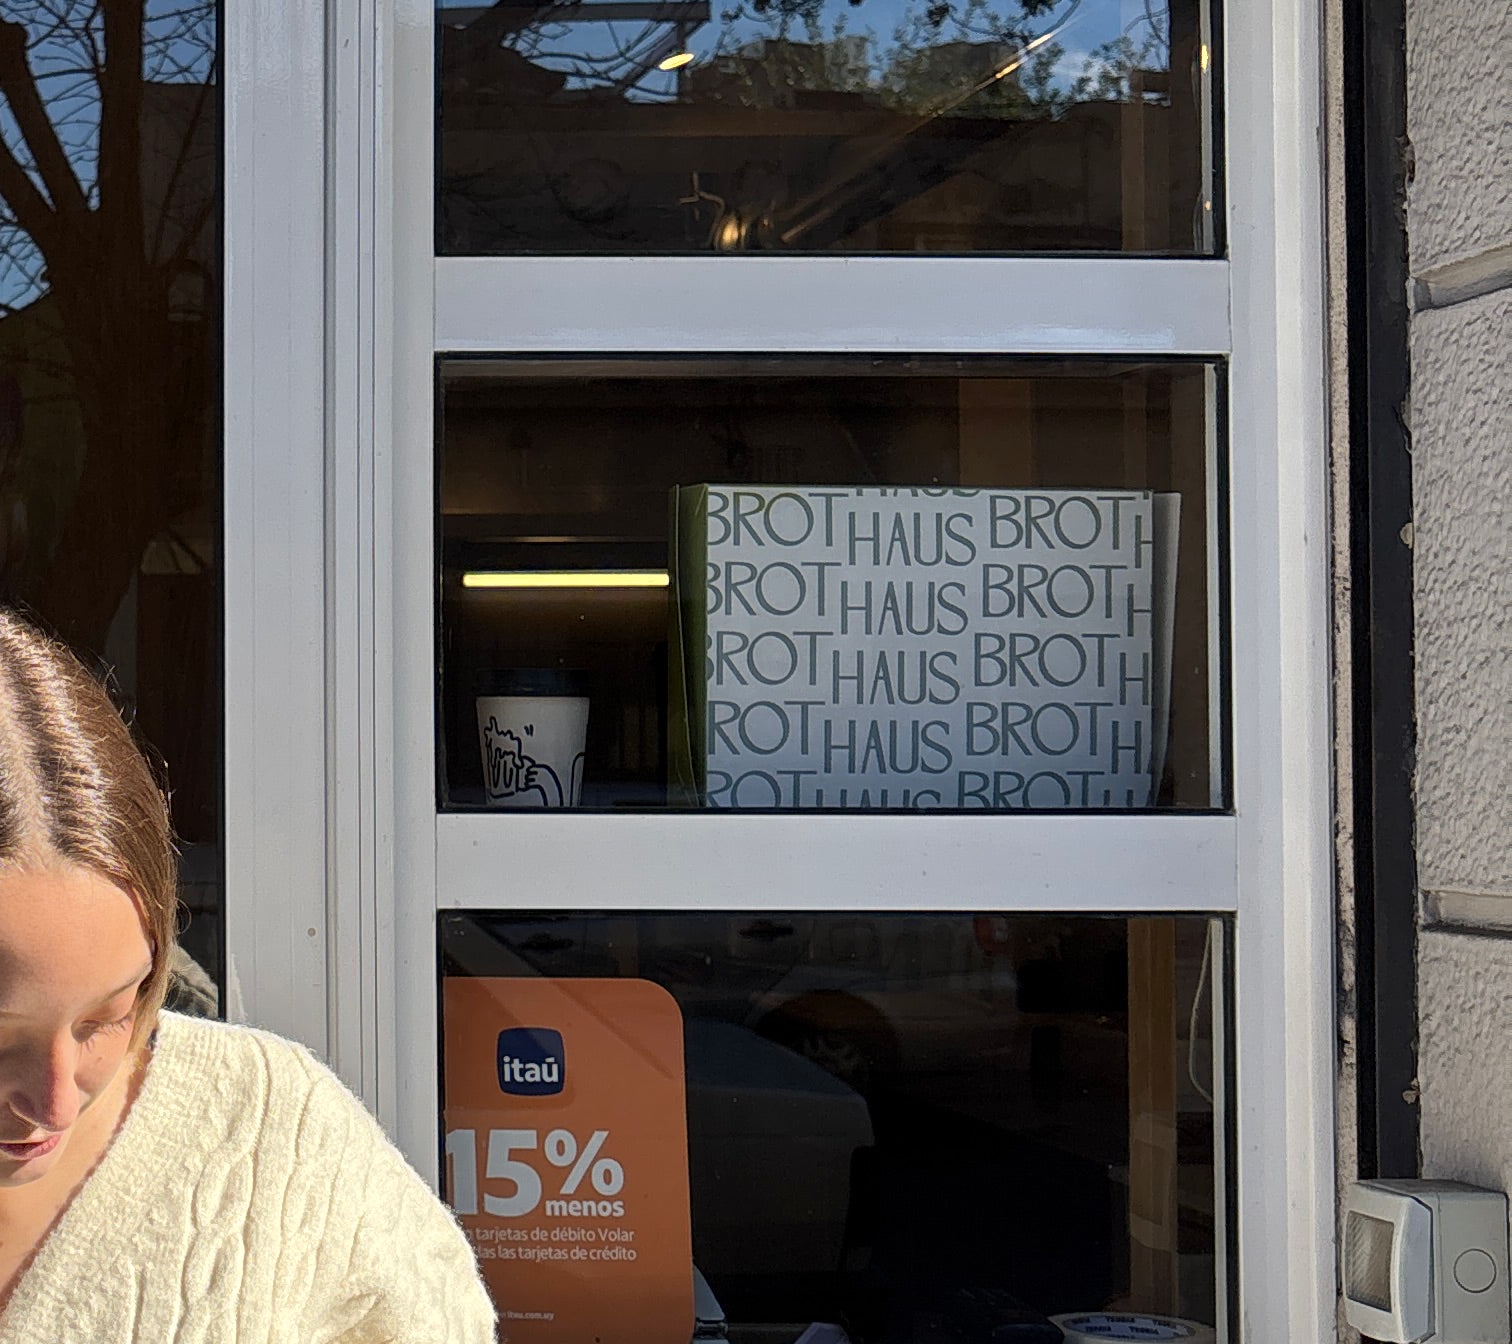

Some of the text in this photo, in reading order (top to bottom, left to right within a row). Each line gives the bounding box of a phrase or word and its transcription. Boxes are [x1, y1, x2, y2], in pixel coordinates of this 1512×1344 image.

[707, 631, 833, 686] ROT
[503, 1056, 559, 1083] itaú
[445, 1129, 625, 1218] 15%
[545, 1198, 625, 1218] menos
[475, 1227, 528, 1244] tarjetas
[530, 1227, 548, 1242] de
[550, 1227, 596, 1243] débito
[598, 1228, 635, 1243] Volar
[498, 1245, 516, 1260] las
[518, 1245, 568, 1263] tarjetas
[570, 1245, 588, 1261] de
[589, 1245, 637, 1262] crédito
